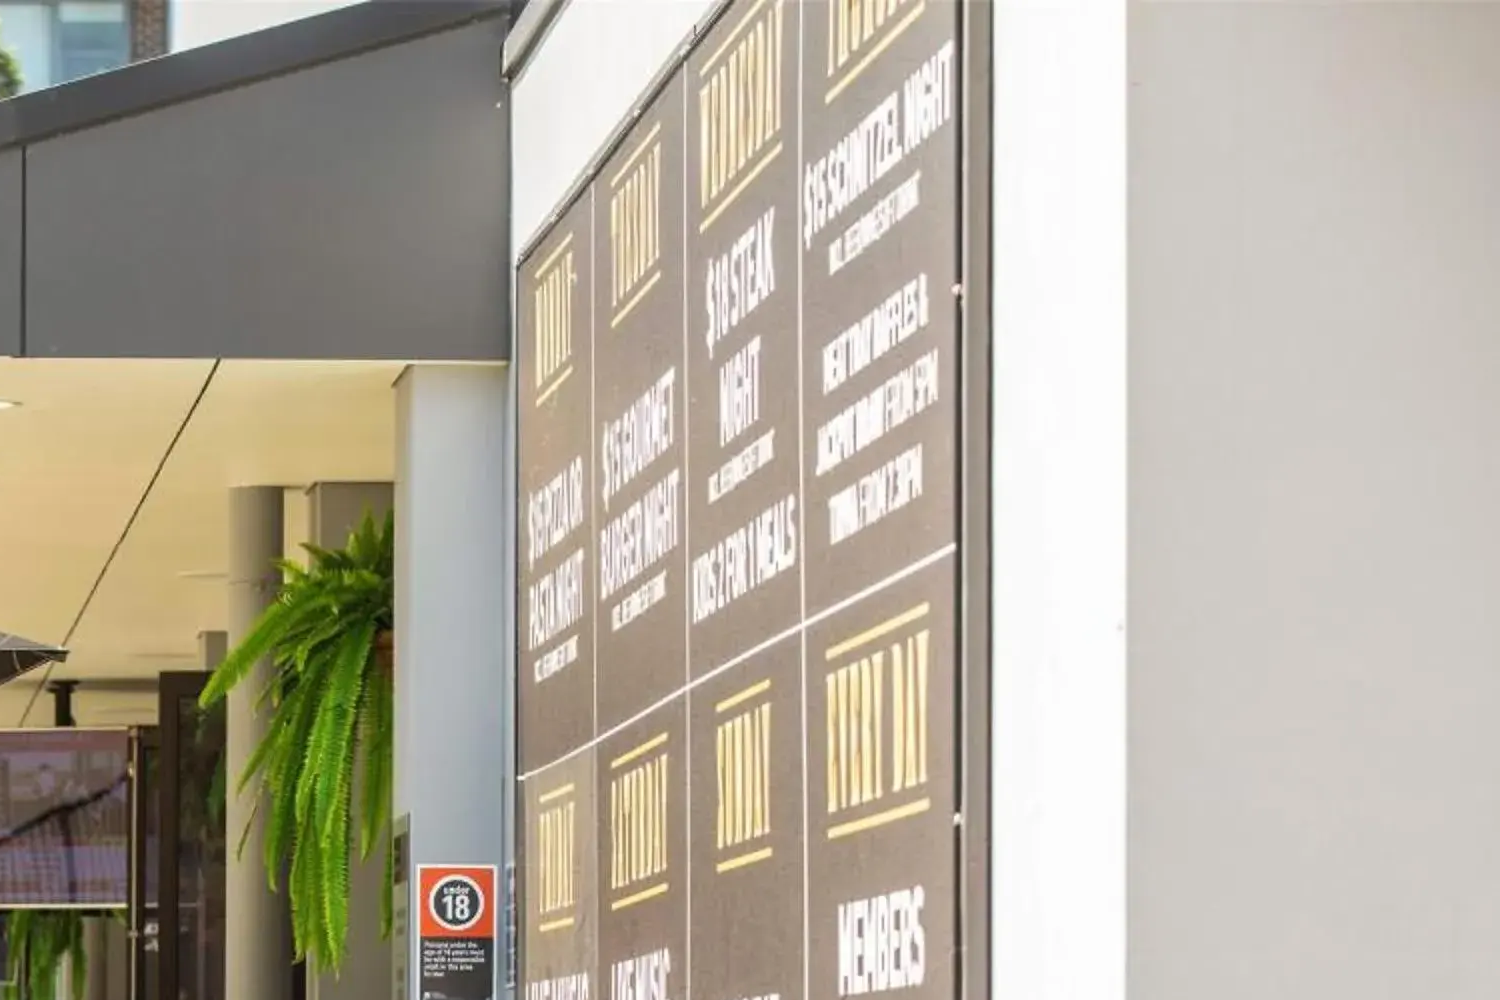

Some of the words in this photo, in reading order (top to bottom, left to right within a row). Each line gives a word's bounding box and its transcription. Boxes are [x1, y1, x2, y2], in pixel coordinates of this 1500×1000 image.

[829, 86, 901, 221] SCHNITZEL
[905, 36, 952, 153] NIGHT
[731, 207, 774, 327] STEAK
[720, 336, 760, 446] NIGHT
[601, 499, 641, 598] BURGER
[693, 548, 715, 622] KIDS
[718, 542, 724, 607] 2
[727, 527, 746, 602] FOR
[749, 522, 754, 589] 1
[756, 495, 795, 584] MEALS
[717, 701, 770, 850] SUNDAY
[827, 649, 882, 815] EVERY
[892, 628, 928, 793] DAY
[442, 895, 470, 921] 18
[443, 885, 470, 895] under
[838, 884, 924, 997] MEMBERS
